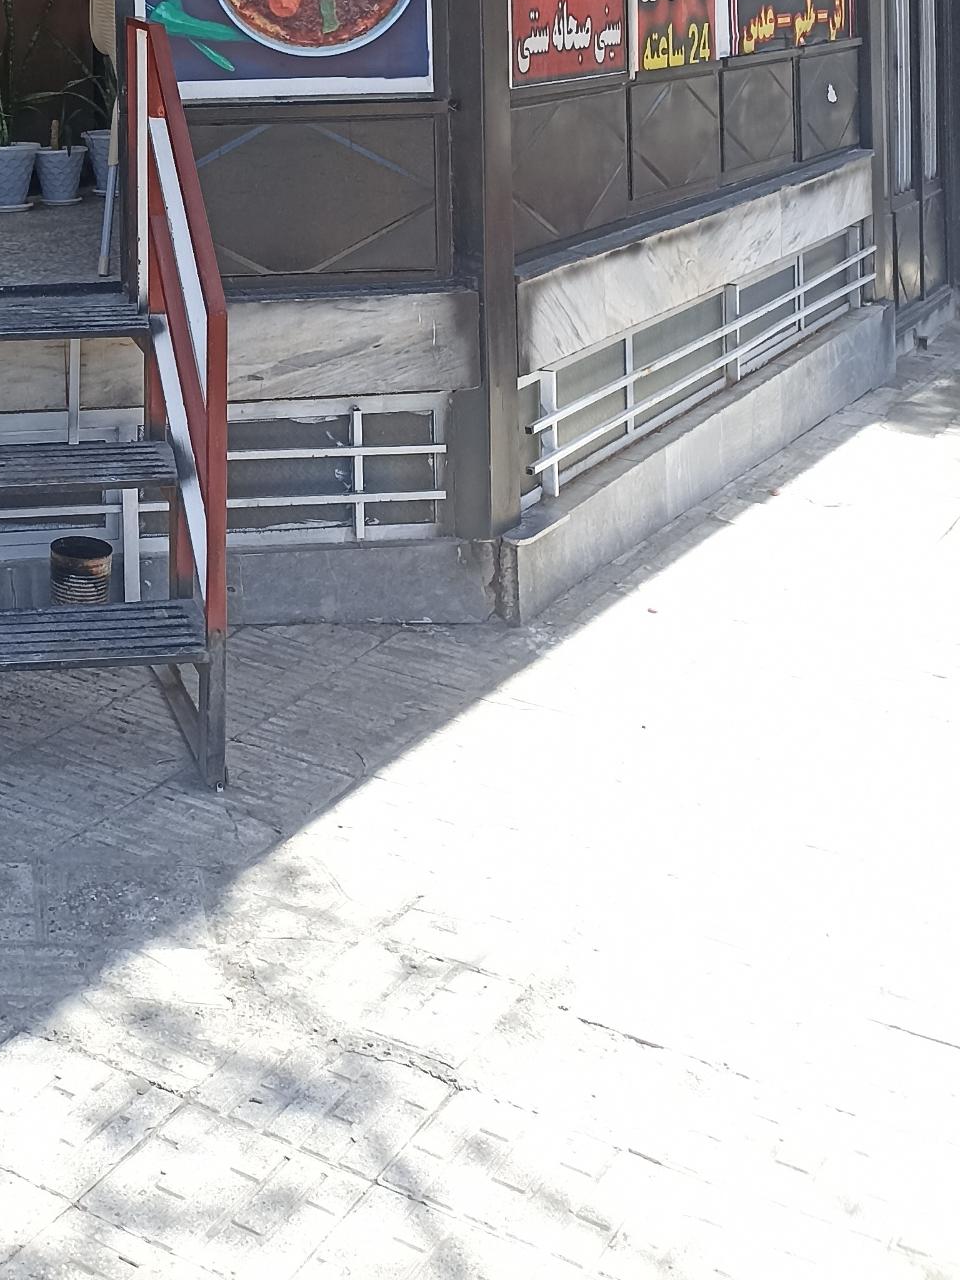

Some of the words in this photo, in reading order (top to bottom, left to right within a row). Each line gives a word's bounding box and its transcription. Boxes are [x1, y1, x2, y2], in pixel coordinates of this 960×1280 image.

[517, 11, 549, 73] سنتی
[552, 0, 591, 63] صبحانه
[594, 6, 621, 63] سینی
[643, 23, 685, 70] ساعته
[689, 22, 711, 64] 24
